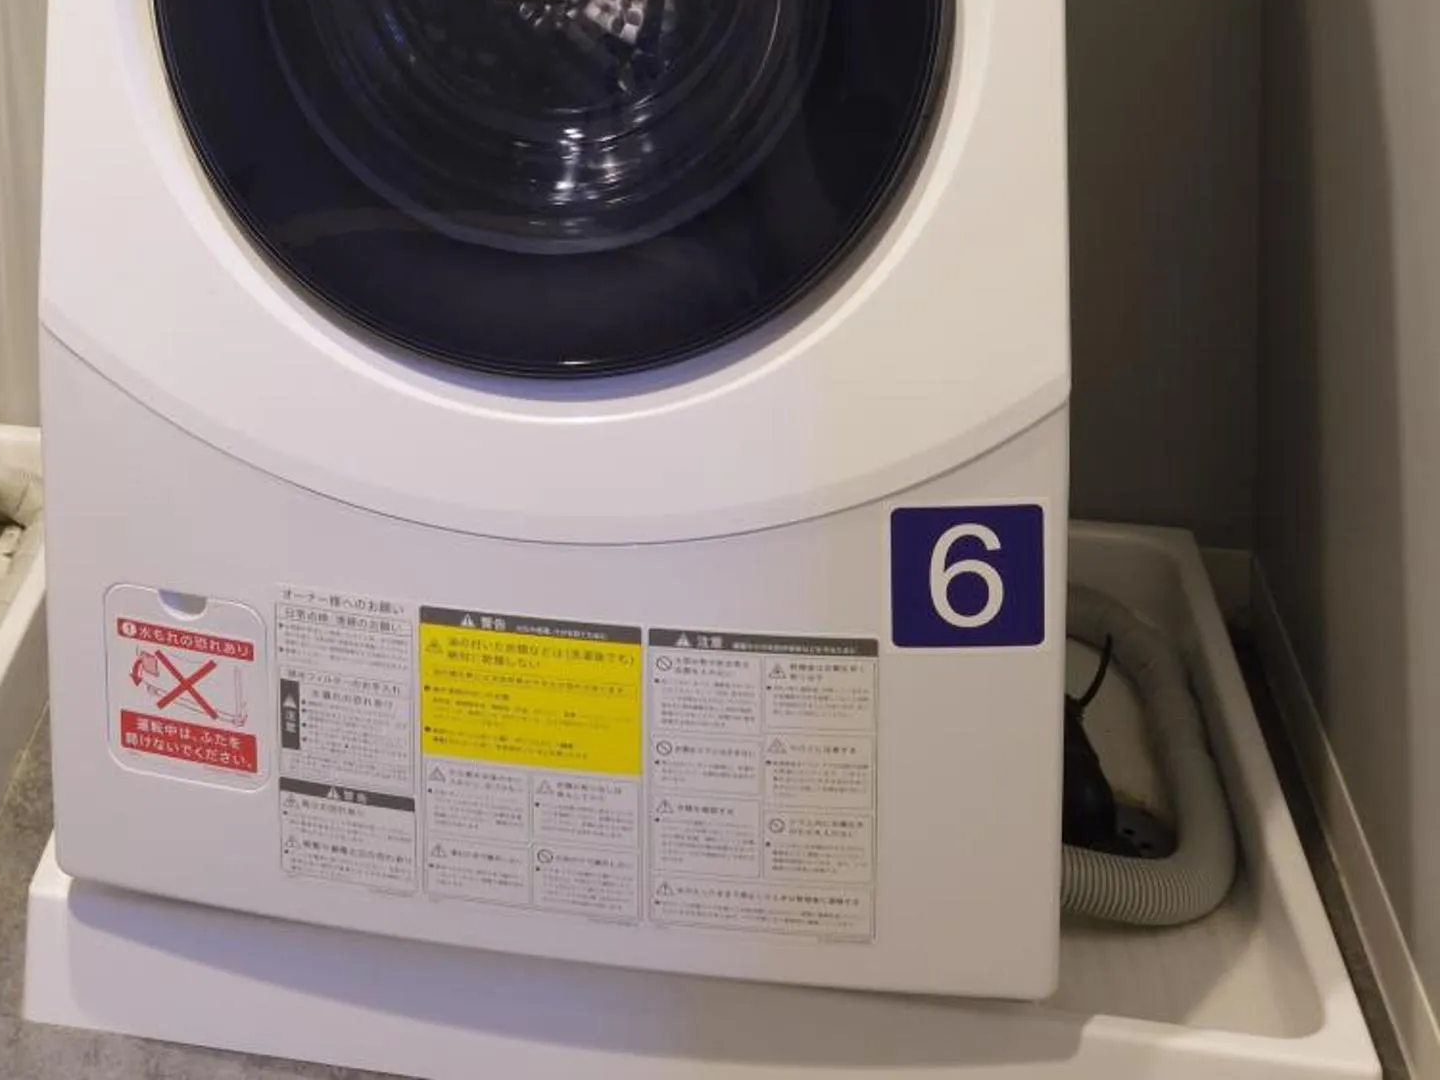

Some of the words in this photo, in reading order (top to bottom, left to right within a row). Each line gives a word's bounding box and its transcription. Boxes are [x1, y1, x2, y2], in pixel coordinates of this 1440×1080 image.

[928, 522, 1005, 628] 6
[282, 590, 404, 615] オーナー様へのお願い
[138, 626, 249, 658] 水もれの恐れあり
[135, 717, 243, 749] 運転中は、ふたを
[124, 731, 253, 769] 開けないでください。
